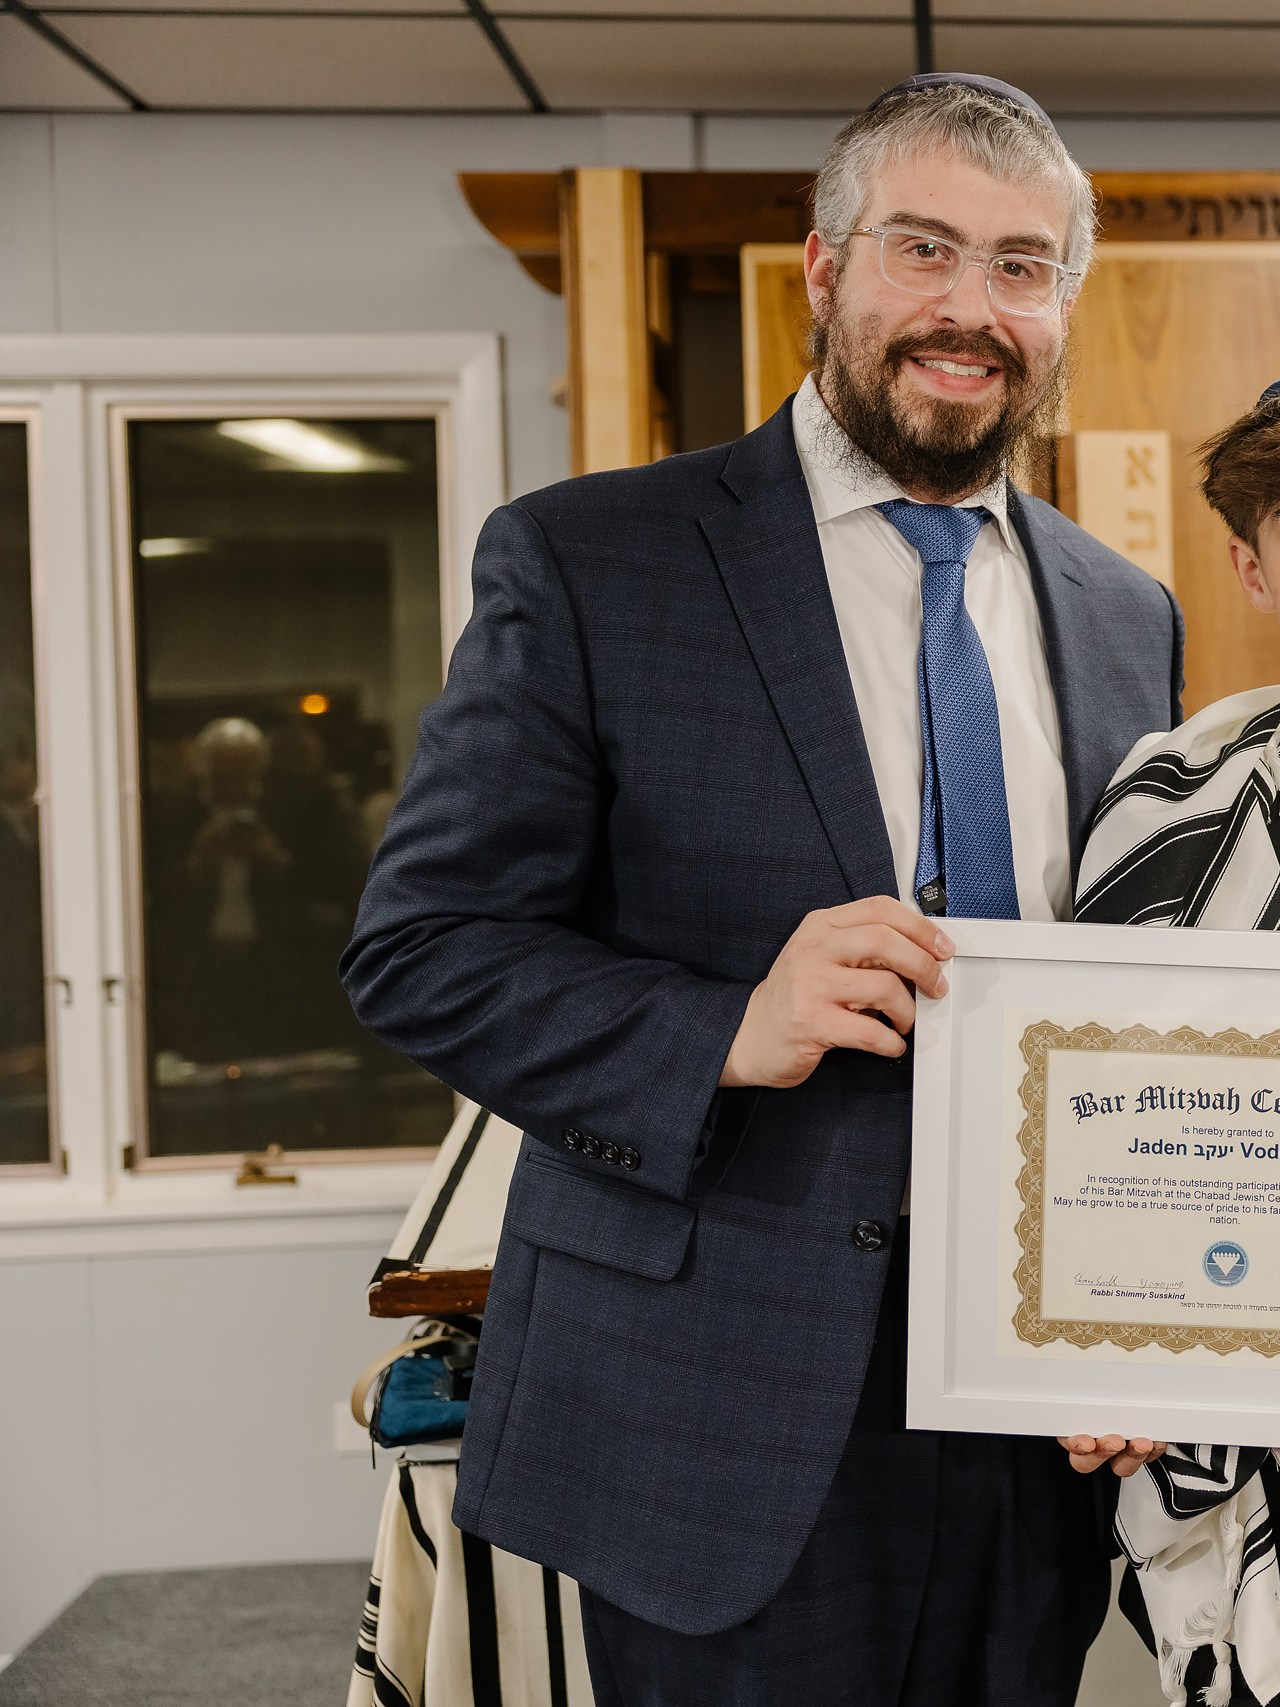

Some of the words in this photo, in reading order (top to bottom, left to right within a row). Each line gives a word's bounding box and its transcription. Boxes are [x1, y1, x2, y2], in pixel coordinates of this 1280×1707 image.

[1125, 447, 1156, 488] א
[1070, 1092, 1126, 1124] Bar
[1135, 1085, 1240, 1115] Mitzvah
[1182, 1126, 1190, 1134] Is
[1193, 1126, 1224, 1138] hereby
[1227, 1128, 1262, 1138] granted
[1128, 1138, 1187, 1155] Jaden
[1194, 1144, 1234, 1160] יעקב
[1088, 1174, 1096, 1183] In
[1099, 1175, 1149, 1186] recognition
[1152, 1176, 1161, 1185] of
[1164, 1177, 1177, 1186] his
[1180, 1178, 1234, 1190] outstanding
[1080, 1186, 1089, 1195] of
[1092, 1187, 1105, 1195] his
[1108, 1187, 1123, 1196] Bar
[1127, 1188, 1162, 1197] Mitzvah
[1165, 1190, 1173, 1198] at
[1176, 1190, 1191, 1199] the
[1194, 1190, 1230, 1200] Chabad
[1233, 1193, 1264, 1202] Jewish
[1053, 1197, 1073, 1207] May
[1076, 1198, 1087, 1206] he
[1090, 1200, 1113, 1208] grow
[1115, 1199, 1124, 1207] to
[1127, 1200, 1138, 1208] be
[1150, 1201, 1168, 1210] true
[1171, 1203, 1202, 1211] source
[1205, 1203, 1213, 1212] of
[1216, 1204, 1239, 1214] pride
[1242, 1205, 1250, 1213] to
[1254, 1206, 1267, 1214] his
[1210, 1216, 1240, 1224] nation.
[1115, 1290, 1147, 1299] Shimmy
[1149, 1292, 1185, 1300] Susskind
